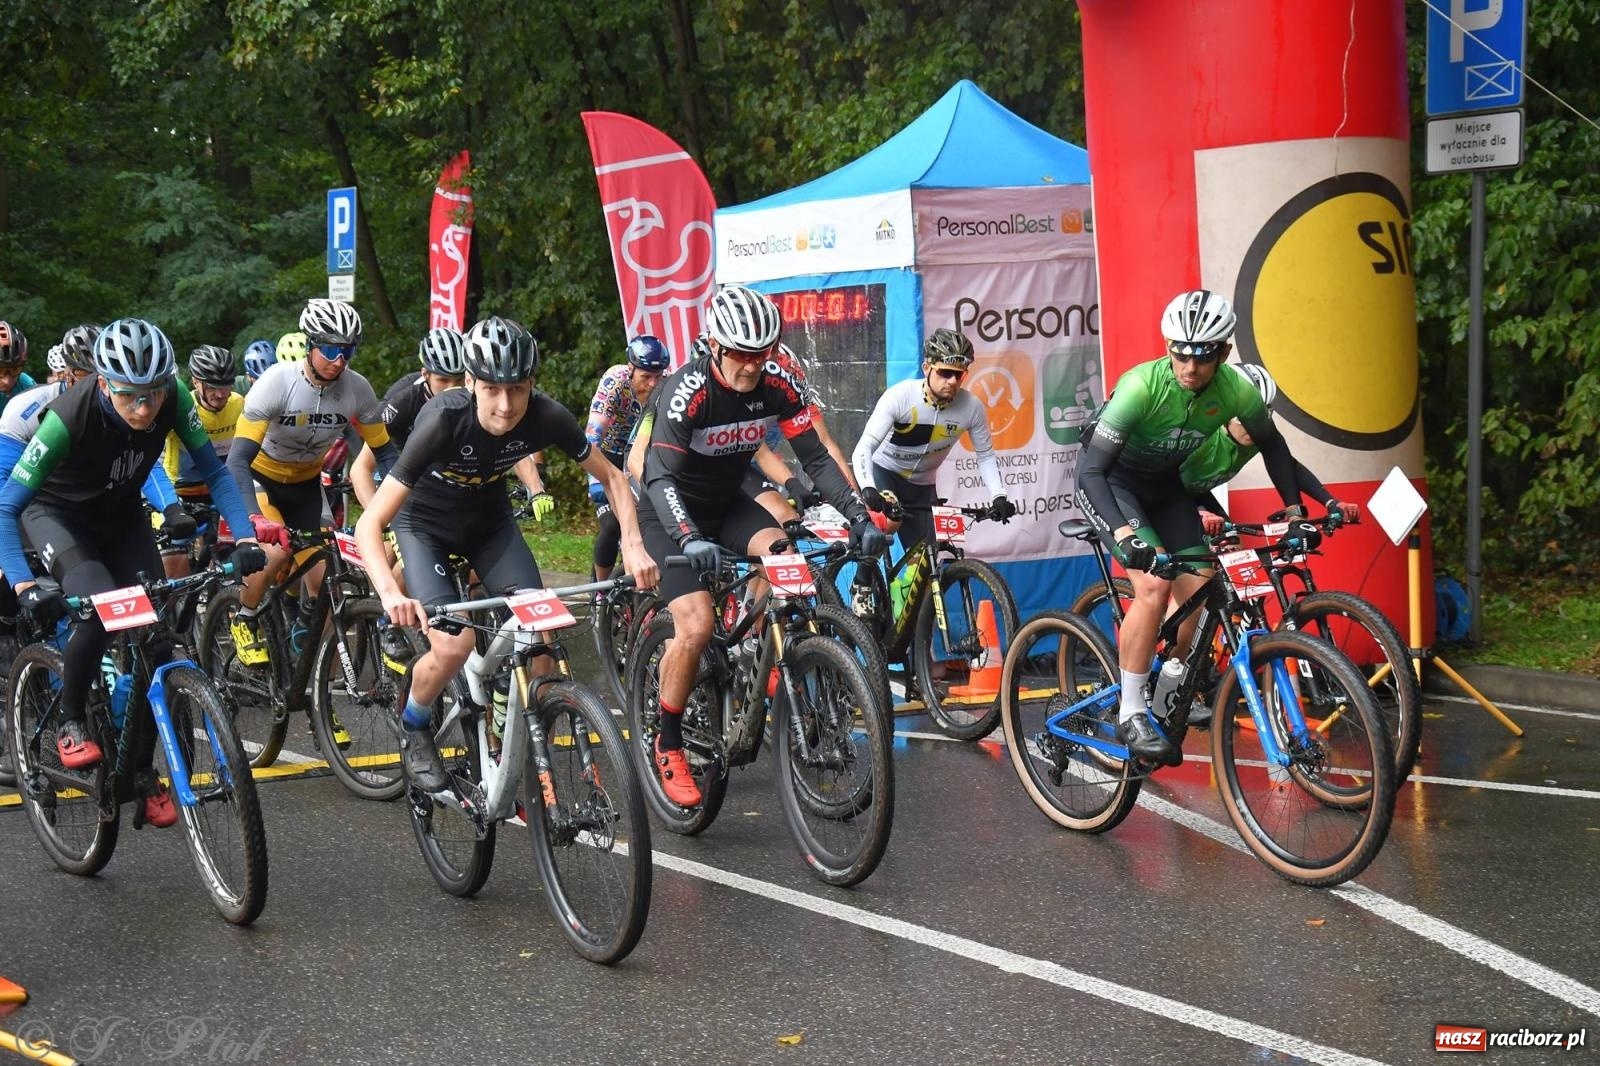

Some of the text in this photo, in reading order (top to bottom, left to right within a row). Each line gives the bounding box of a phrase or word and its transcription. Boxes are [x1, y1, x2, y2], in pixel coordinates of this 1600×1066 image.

[1450, 0, 1503, 63] P
[1455, 121, 1491, 136] Miejsce
[1490, 136, 1506, 146] dla
[1451, 152, 1496, 166] autobusu
[333, 196, 350, 249] P
[937, 213, 1055, 238] PersonalBest
[875, 228, 896, 242] MITKO
[727, 234, 793, 258] PersonalBest
[278, 413, 333, 427] TAURUS
[706, 423, 766, 447] SOKÓŁ
[1005, 470, 1037, 486] CZASU
[940, 518, 959, 530] 30
[775, 567, 803, 582] 22
[109, 599, 137, 616] 37
[525, 603, 553, 618] 10
